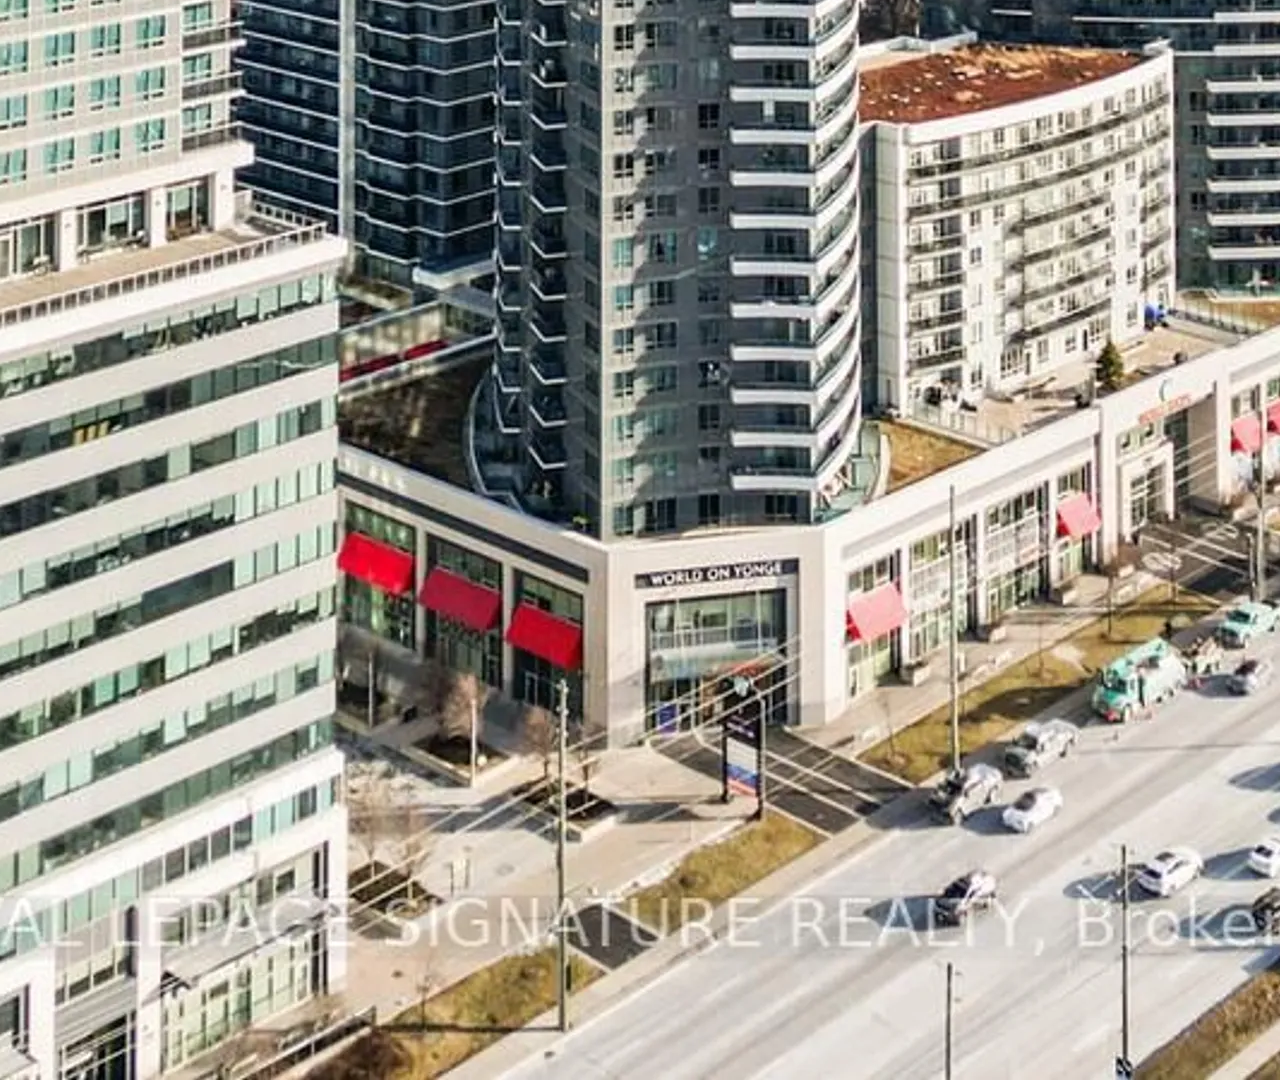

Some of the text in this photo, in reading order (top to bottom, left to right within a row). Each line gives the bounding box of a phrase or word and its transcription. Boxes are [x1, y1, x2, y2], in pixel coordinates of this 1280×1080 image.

[651, 562, 782, 585] WORLD ON YONGE
